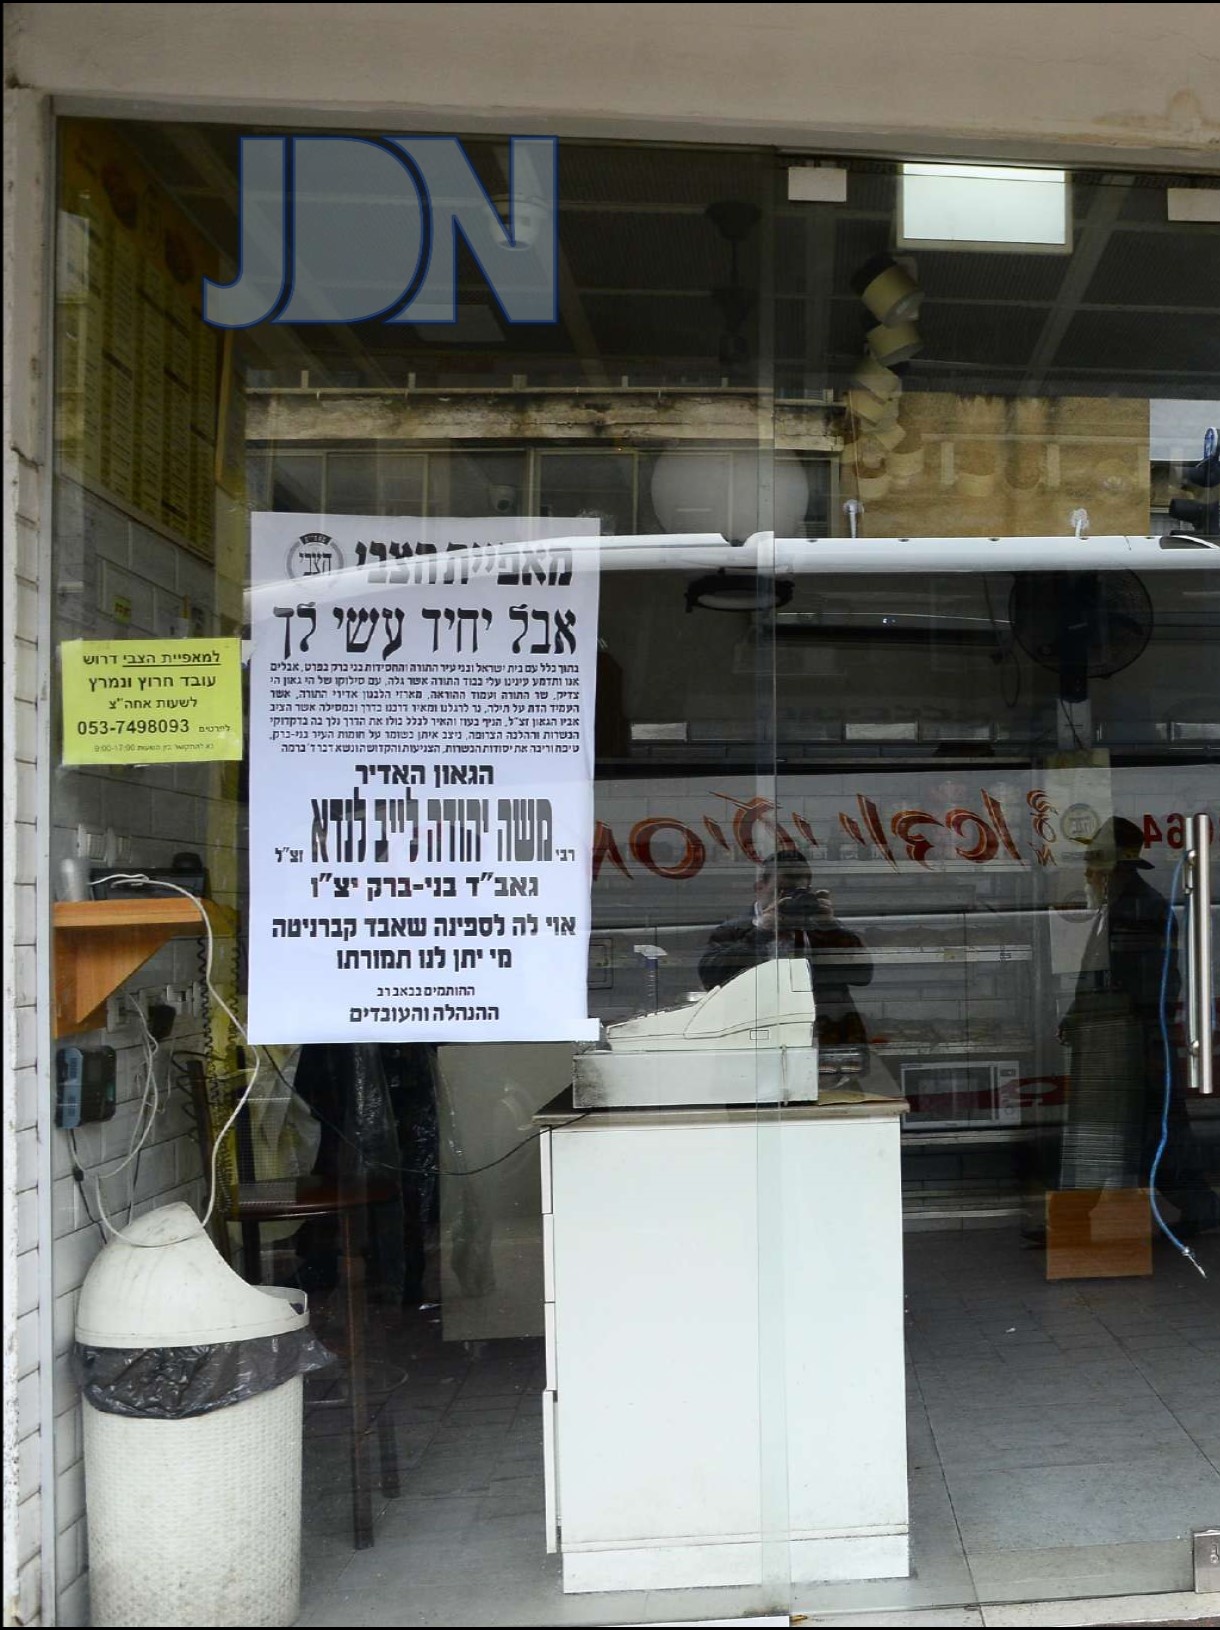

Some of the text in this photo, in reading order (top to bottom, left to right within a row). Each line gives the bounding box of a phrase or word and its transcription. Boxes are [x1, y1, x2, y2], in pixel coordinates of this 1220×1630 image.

[354, 540, 574, 586] מאפיית הצבי
[272, 601, 577, 661] אבל יחיד עשי לך
[83, 651, 220, 665] למאפיית הצבי דרוש
[89, 676, 216, 692] עובד חרוץ ונמרץ
[78, 719, 189, 735] 053-7498093
[355, 765, 493, 787] הגאון האדיר
[310, 786, 367, 864] לנדא
[374, 786, 419, 863] לייב
[427, 798, 490, 863] יהודה
[497, 798, 553, 863] משה
[555, 849, 576, 862] רבי
[311, 872, 538, 901] גאב"ד בני-ברק יצ"ו
[273, 914, 576, 941] אוי לה לספינה שאבד קברניטה
[337, 946, 512, 972] מי יתן לנו תמורתו
[377, 986, 475, 996] החותמים בכאב רב
[350, 1004, 499, 1023] ההנהלה והעובדים
